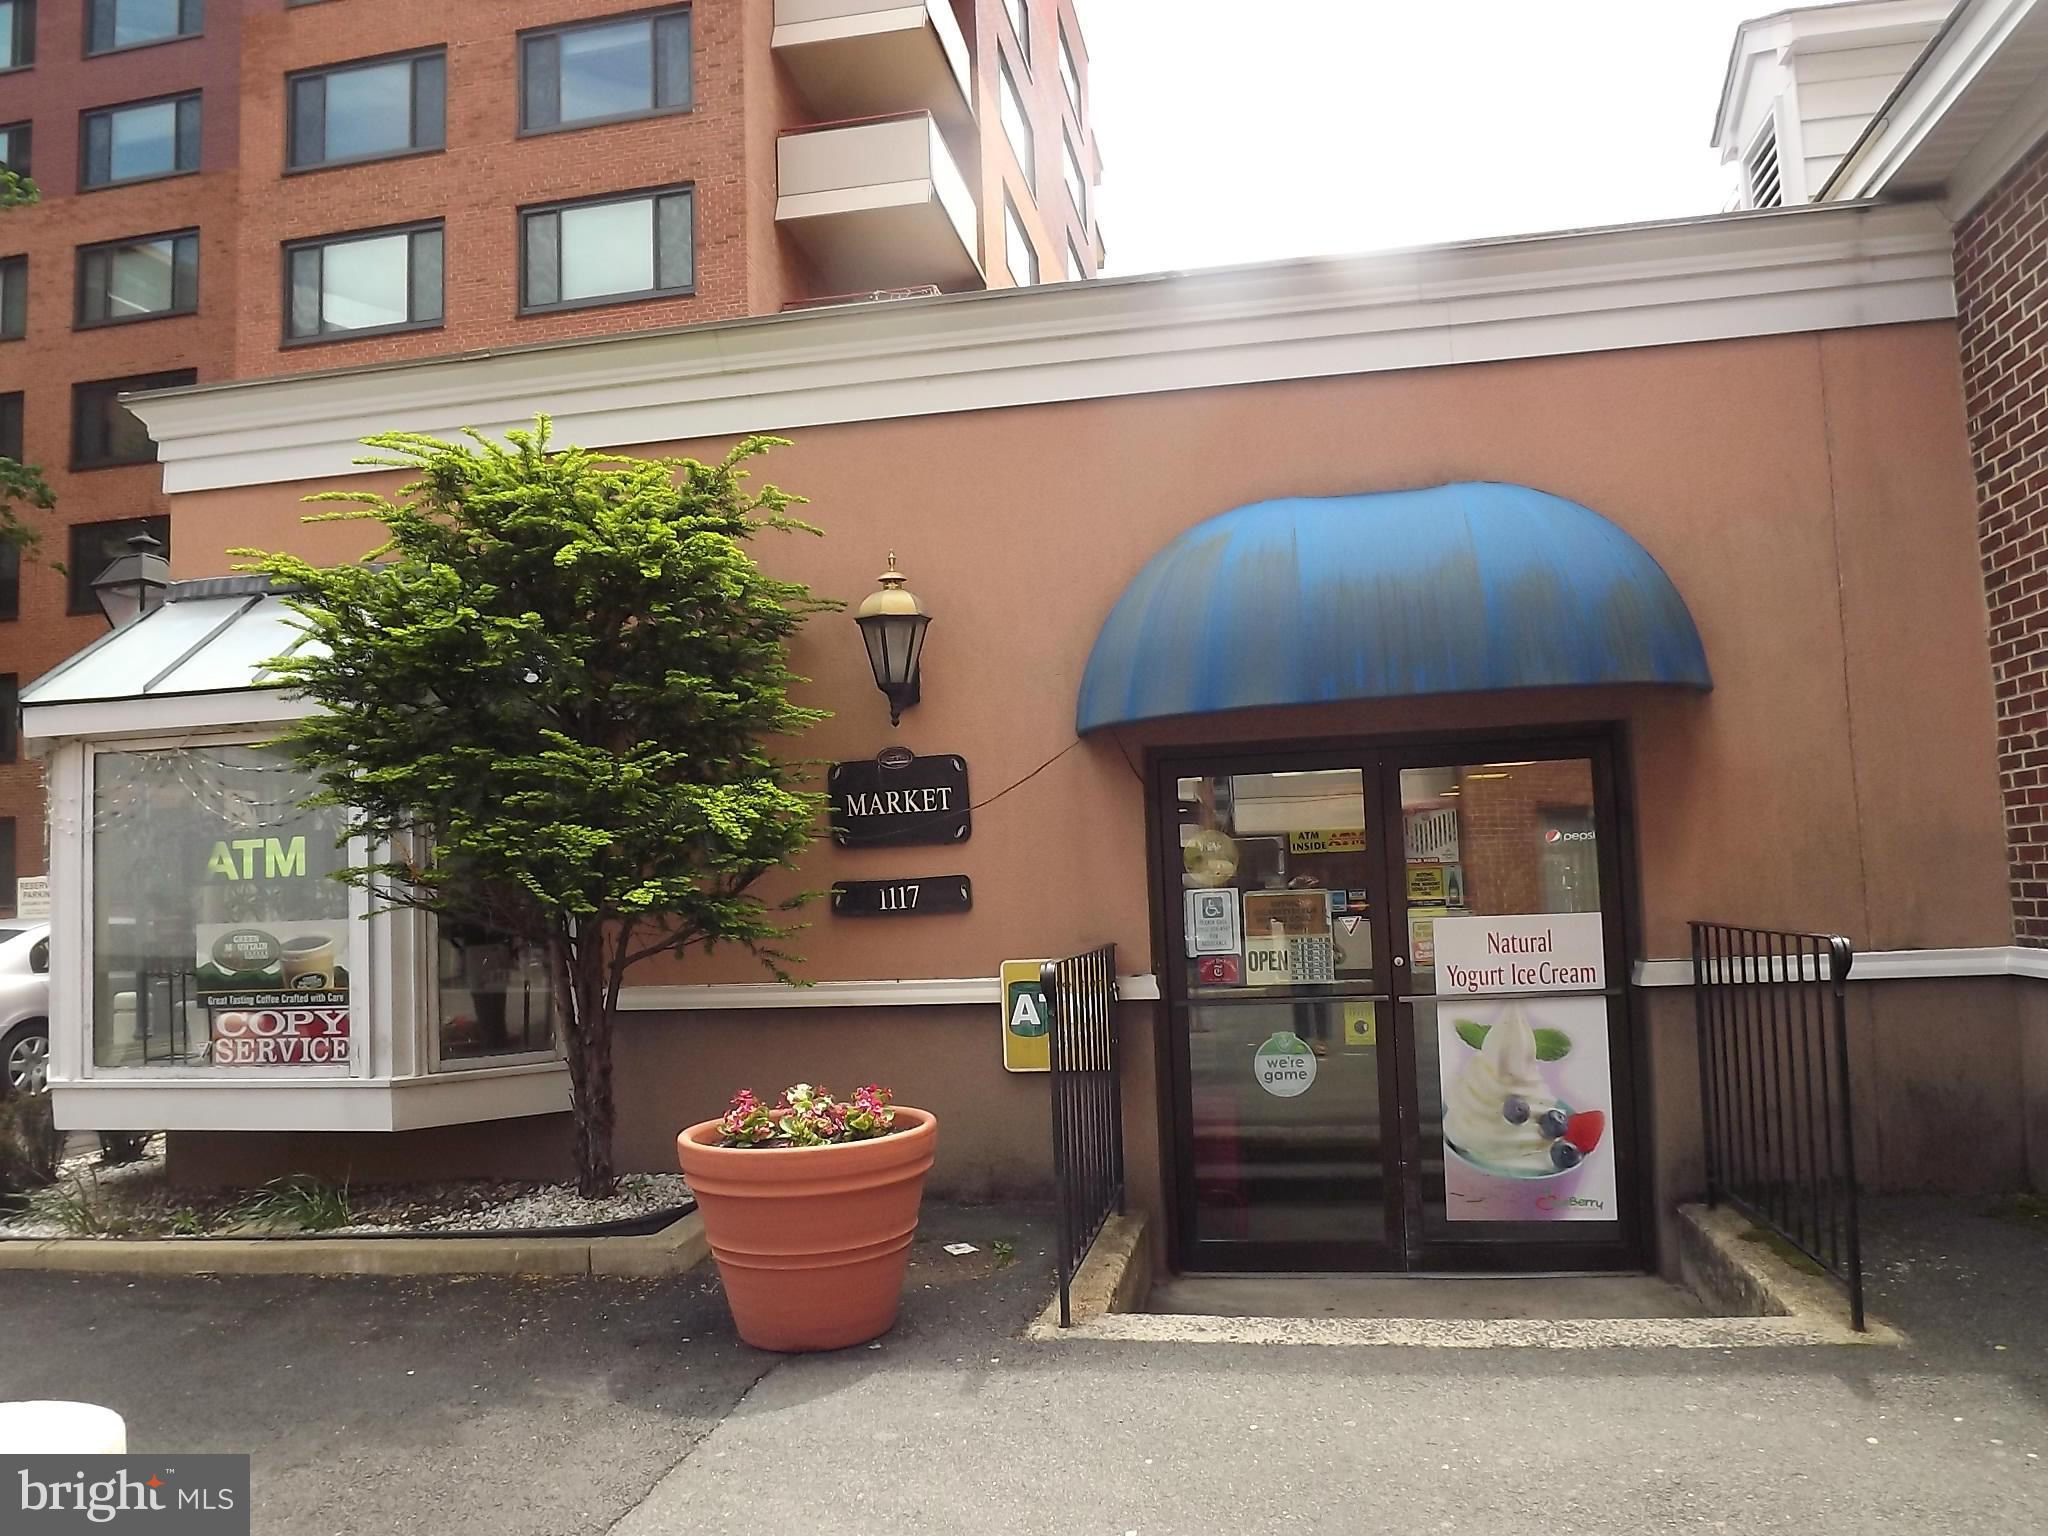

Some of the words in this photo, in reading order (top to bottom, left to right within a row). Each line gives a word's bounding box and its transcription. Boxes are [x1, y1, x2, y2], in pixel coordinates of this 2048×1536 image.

[846, 787, 952, 817] MARKET
[1293, 841, 1327, 851] INSIDE
[1299, 832, 1319, 840] ATM
[1563, 831, 1596, 842] pepsi
[207, 836, 305, 881] ATM
[879, 885, 920, 910] 1117
[1487, 929, 1553, 954] Natural
[1248, 950, 1288, 972] OPEN
[1446, 964, 1505, 992] Yogurt
[1511, 963, 1536, 985] Ice
[1539, 962, 1597, 985] Cream
[207, 996, 228, 1006] Great
[229, 995, 255, 1007] Tasting
[256, 994, 280, 1005] Coffee
[281, 993, 309, 1004] Crafted
[310, 993, 326, 1003] with
[327, 992, 344, 1002] Care
[216, 1010, 349, 1037] COPY
[215, 1037, 350, 1063] SERVICE
[1266, 1056, 1305, 1068] we're
[1263, 1070, 1308, 1084] game
